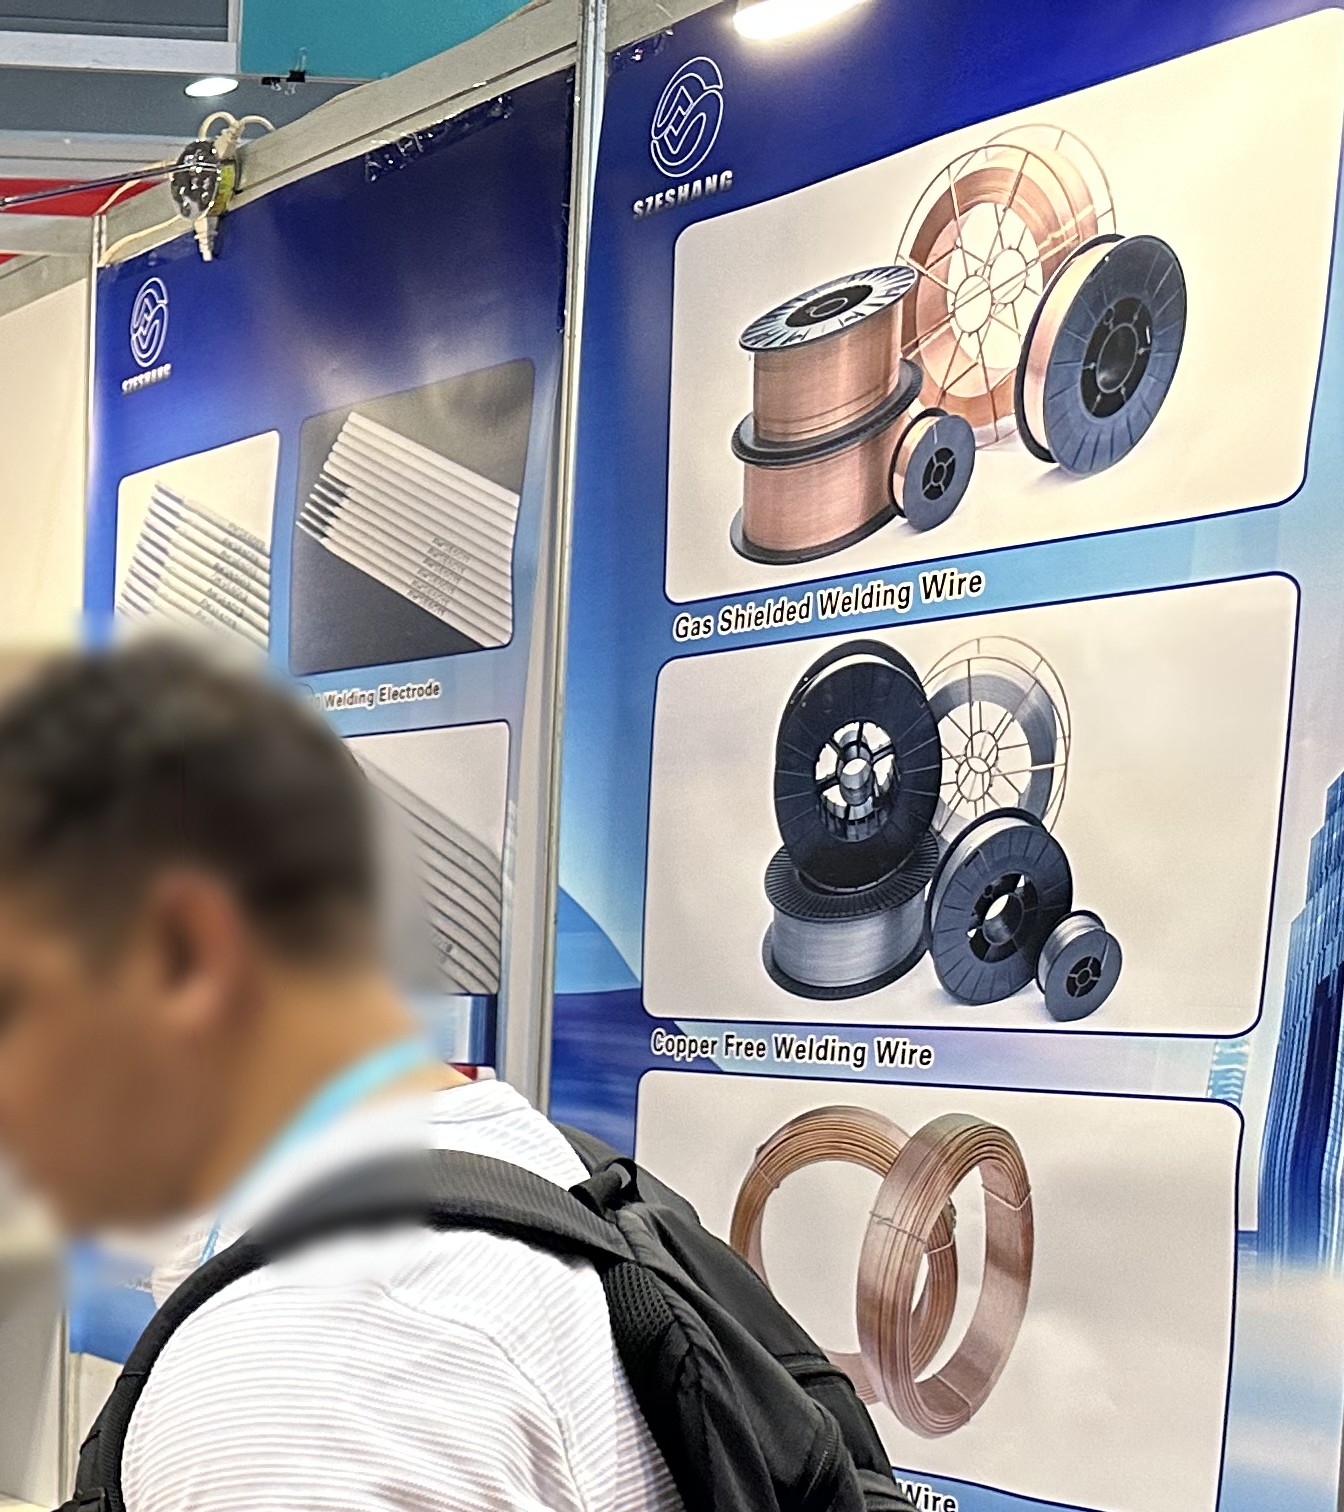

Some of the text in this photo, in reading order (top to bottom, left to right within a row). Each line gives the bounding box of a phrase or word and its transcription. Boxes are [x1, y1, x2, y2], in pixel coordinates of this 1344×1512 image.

[632, 170, 734, 221] SZESHANG
[672, 568, 985, 641] Gas Shielded Welding Wire
[323, 690, 377, 711] Welding
[378, 679, 441, 703] Electrode
[652, 1030, 934, 1070] Copper Free Welding Wire
